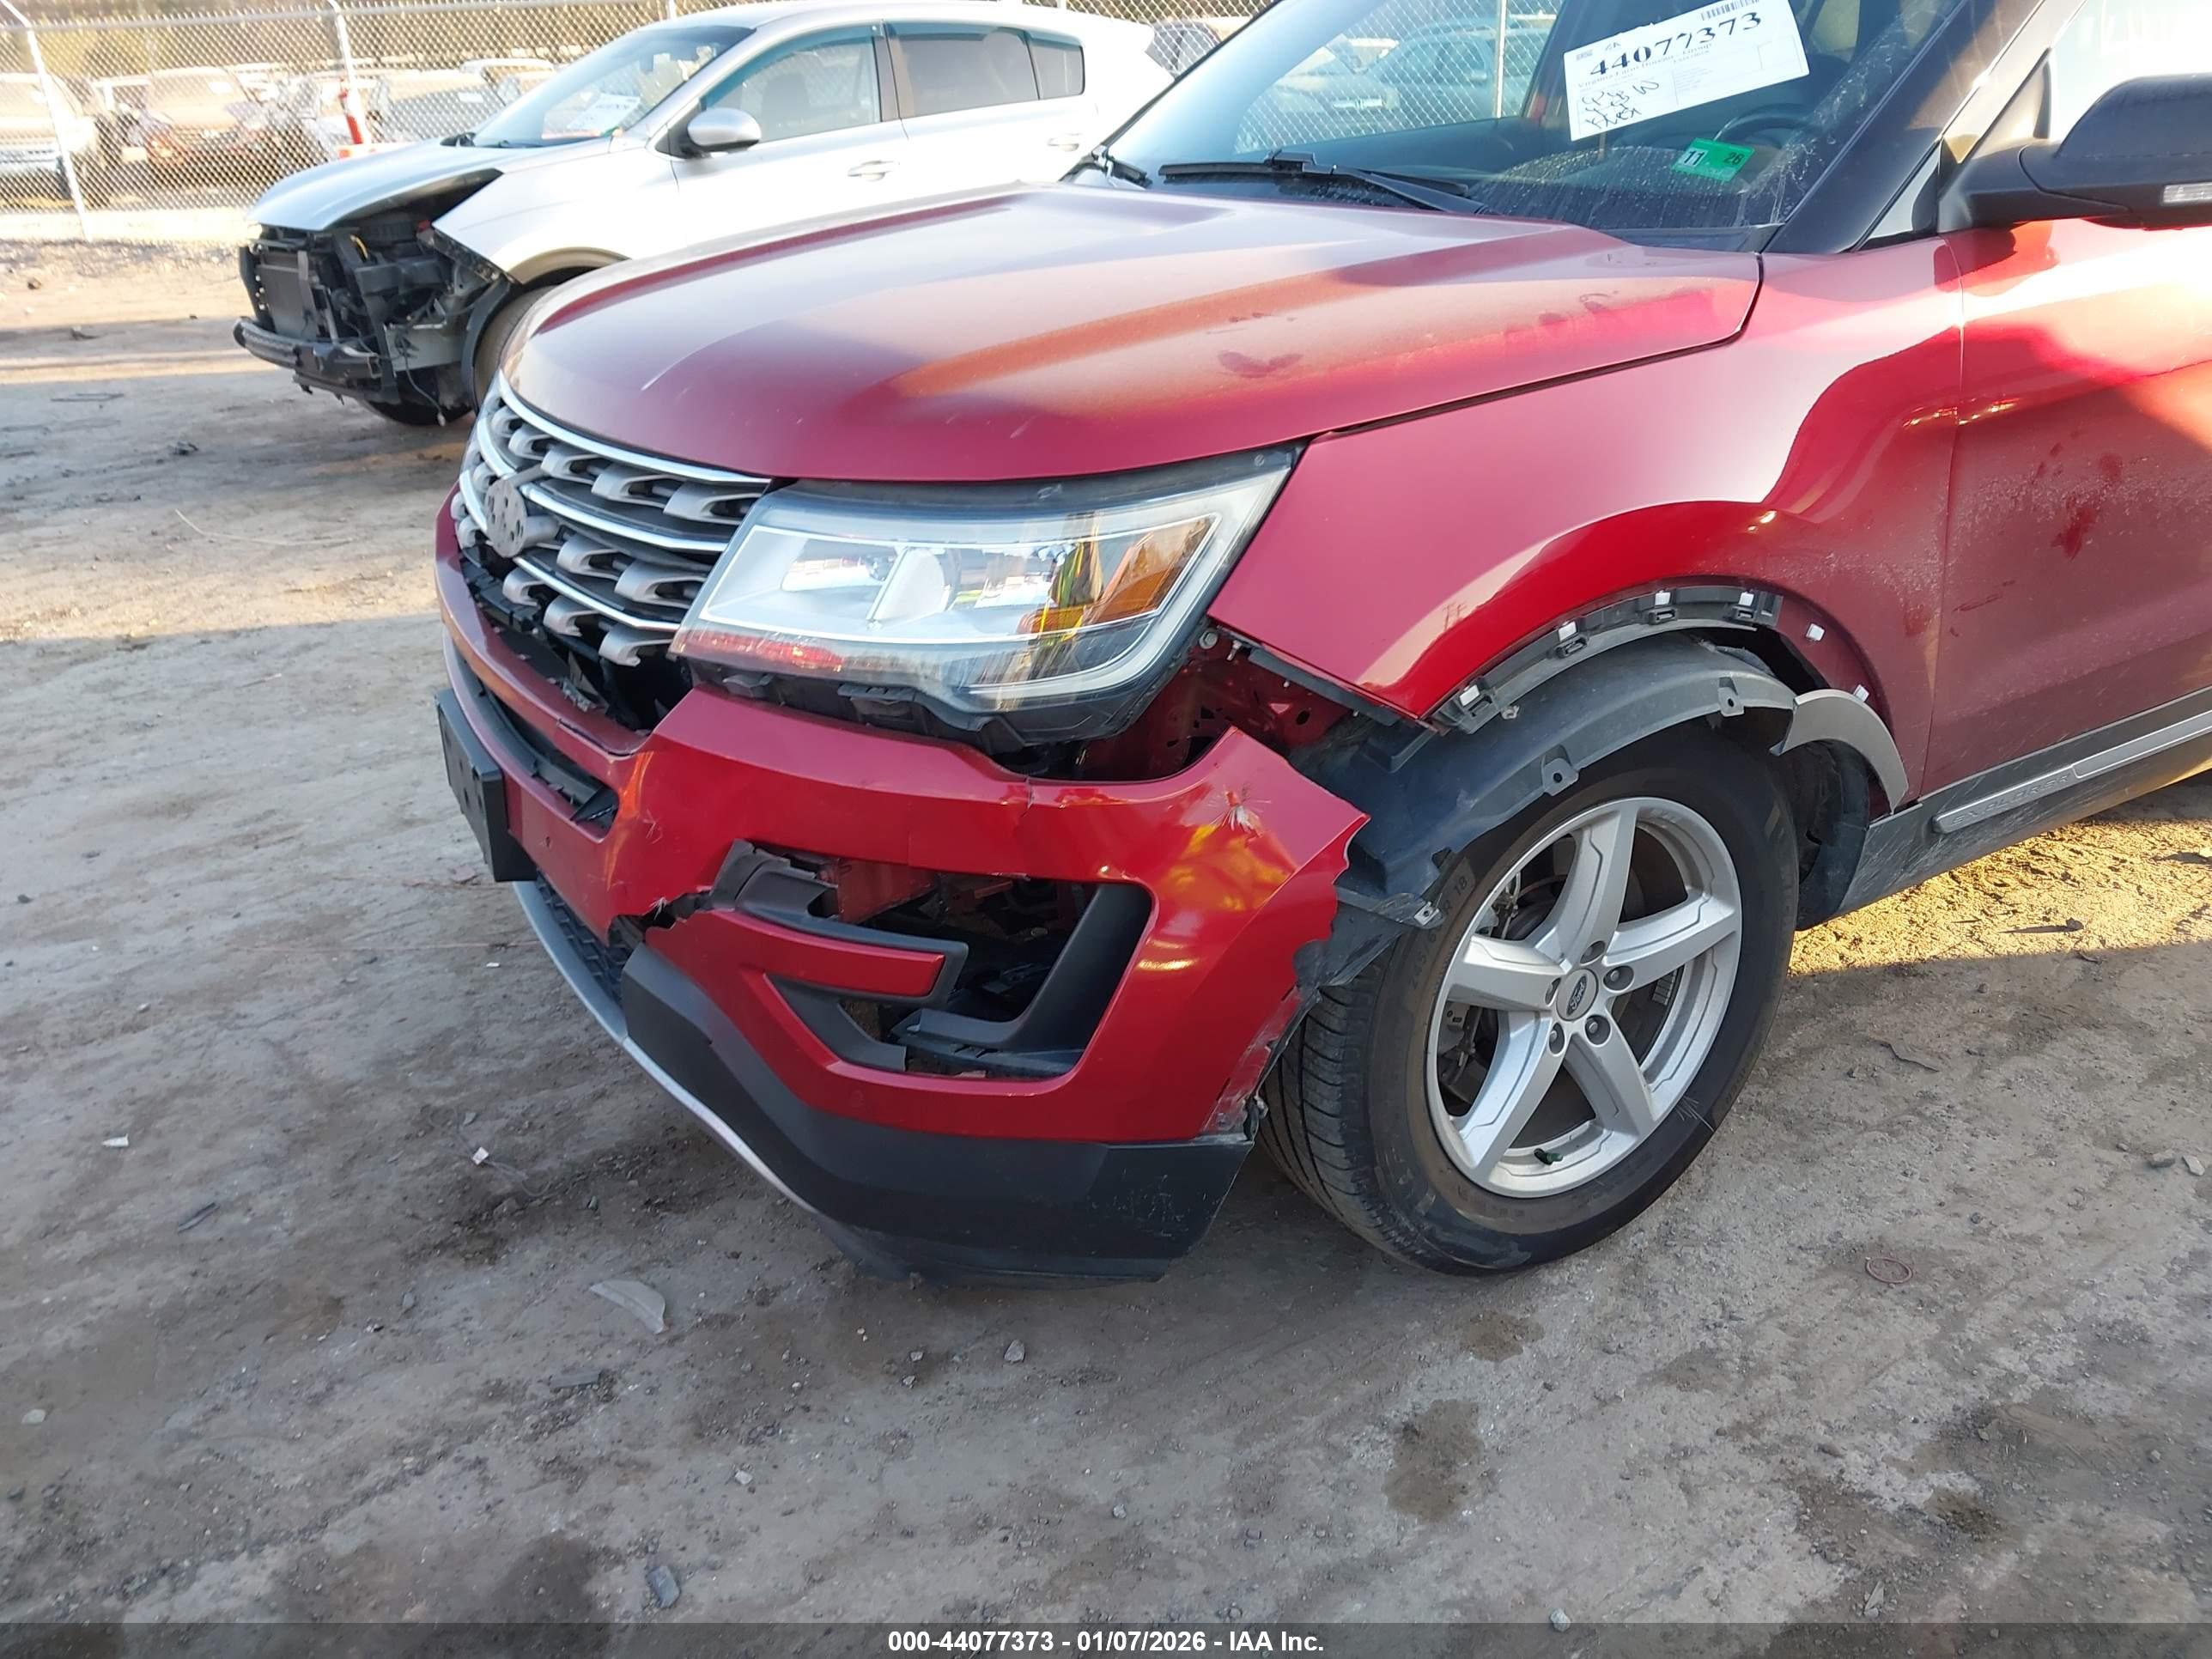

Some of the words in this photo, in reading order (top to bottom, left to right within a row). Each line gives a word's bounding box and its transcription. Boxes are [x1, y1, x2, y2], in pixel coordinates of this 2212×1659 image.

[1589, 11, 1762, 76] 44077373
[1684, 150, 1705, 166] 11
[1569, 981, 1585, 1010] Ford
